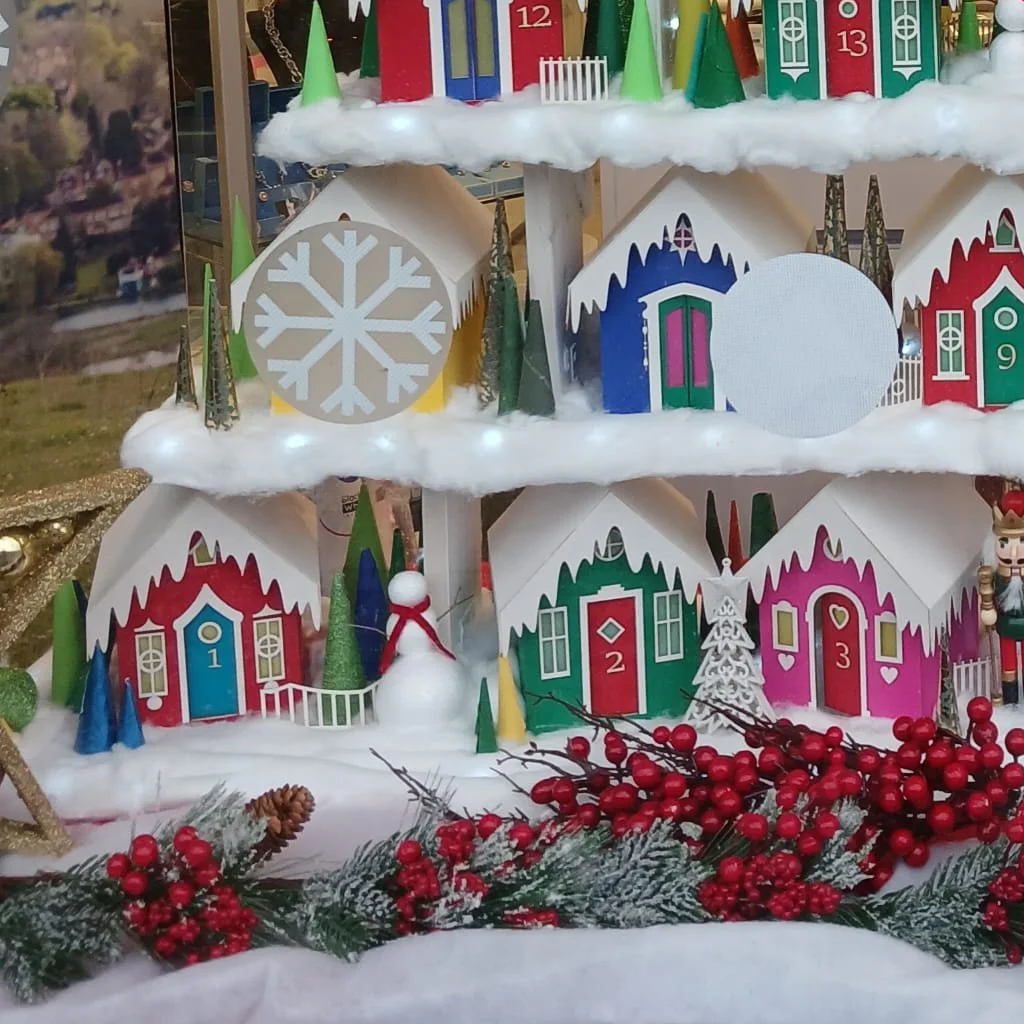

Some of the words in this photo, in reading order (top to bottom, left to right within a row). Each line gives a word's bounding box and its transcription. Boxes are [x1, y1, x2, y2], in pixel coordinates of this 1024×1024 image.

[517, 5, 552, 28] 12
[837, 30, 867, 56] 13
[997, 344, 1016, 369] 9
[208, 649, 221, 668] 1
[606, 652, 625, 673] 2
[836, 643, 850, 668] 3
